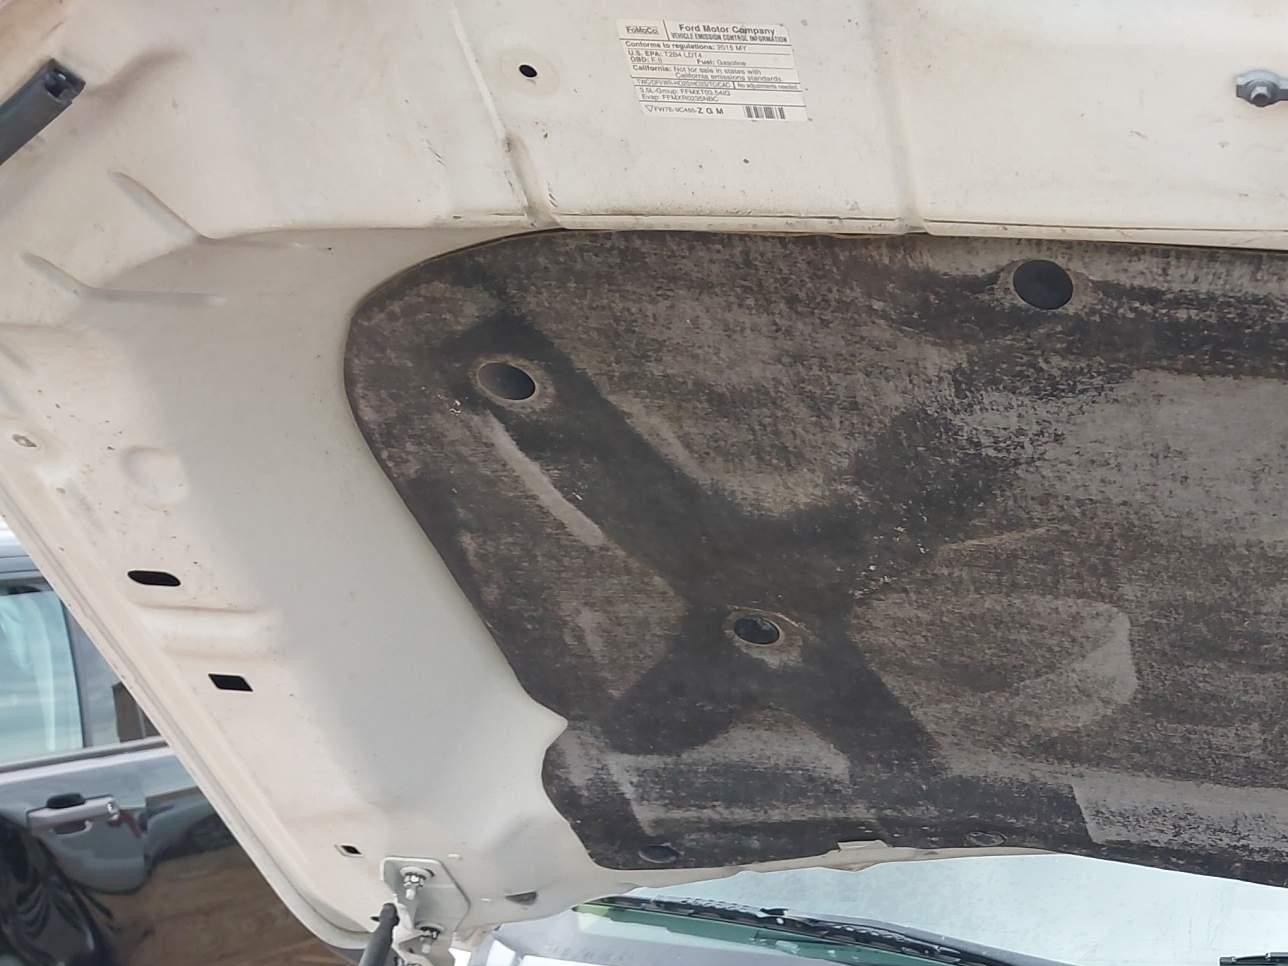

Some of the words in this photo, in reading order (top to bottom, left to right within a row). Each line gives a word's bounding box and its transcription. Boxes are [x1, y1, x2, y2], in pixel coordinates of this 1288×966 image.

[625, 25, 659, 35] FoMoCo
[679, 24, 700, 32] Ford
[702, 25, 729, 33] Motor
[731, 26, 775, 36] Company
[671, 32, 693, 40] VEHICLE
[632, 64, 672, 72] California:
